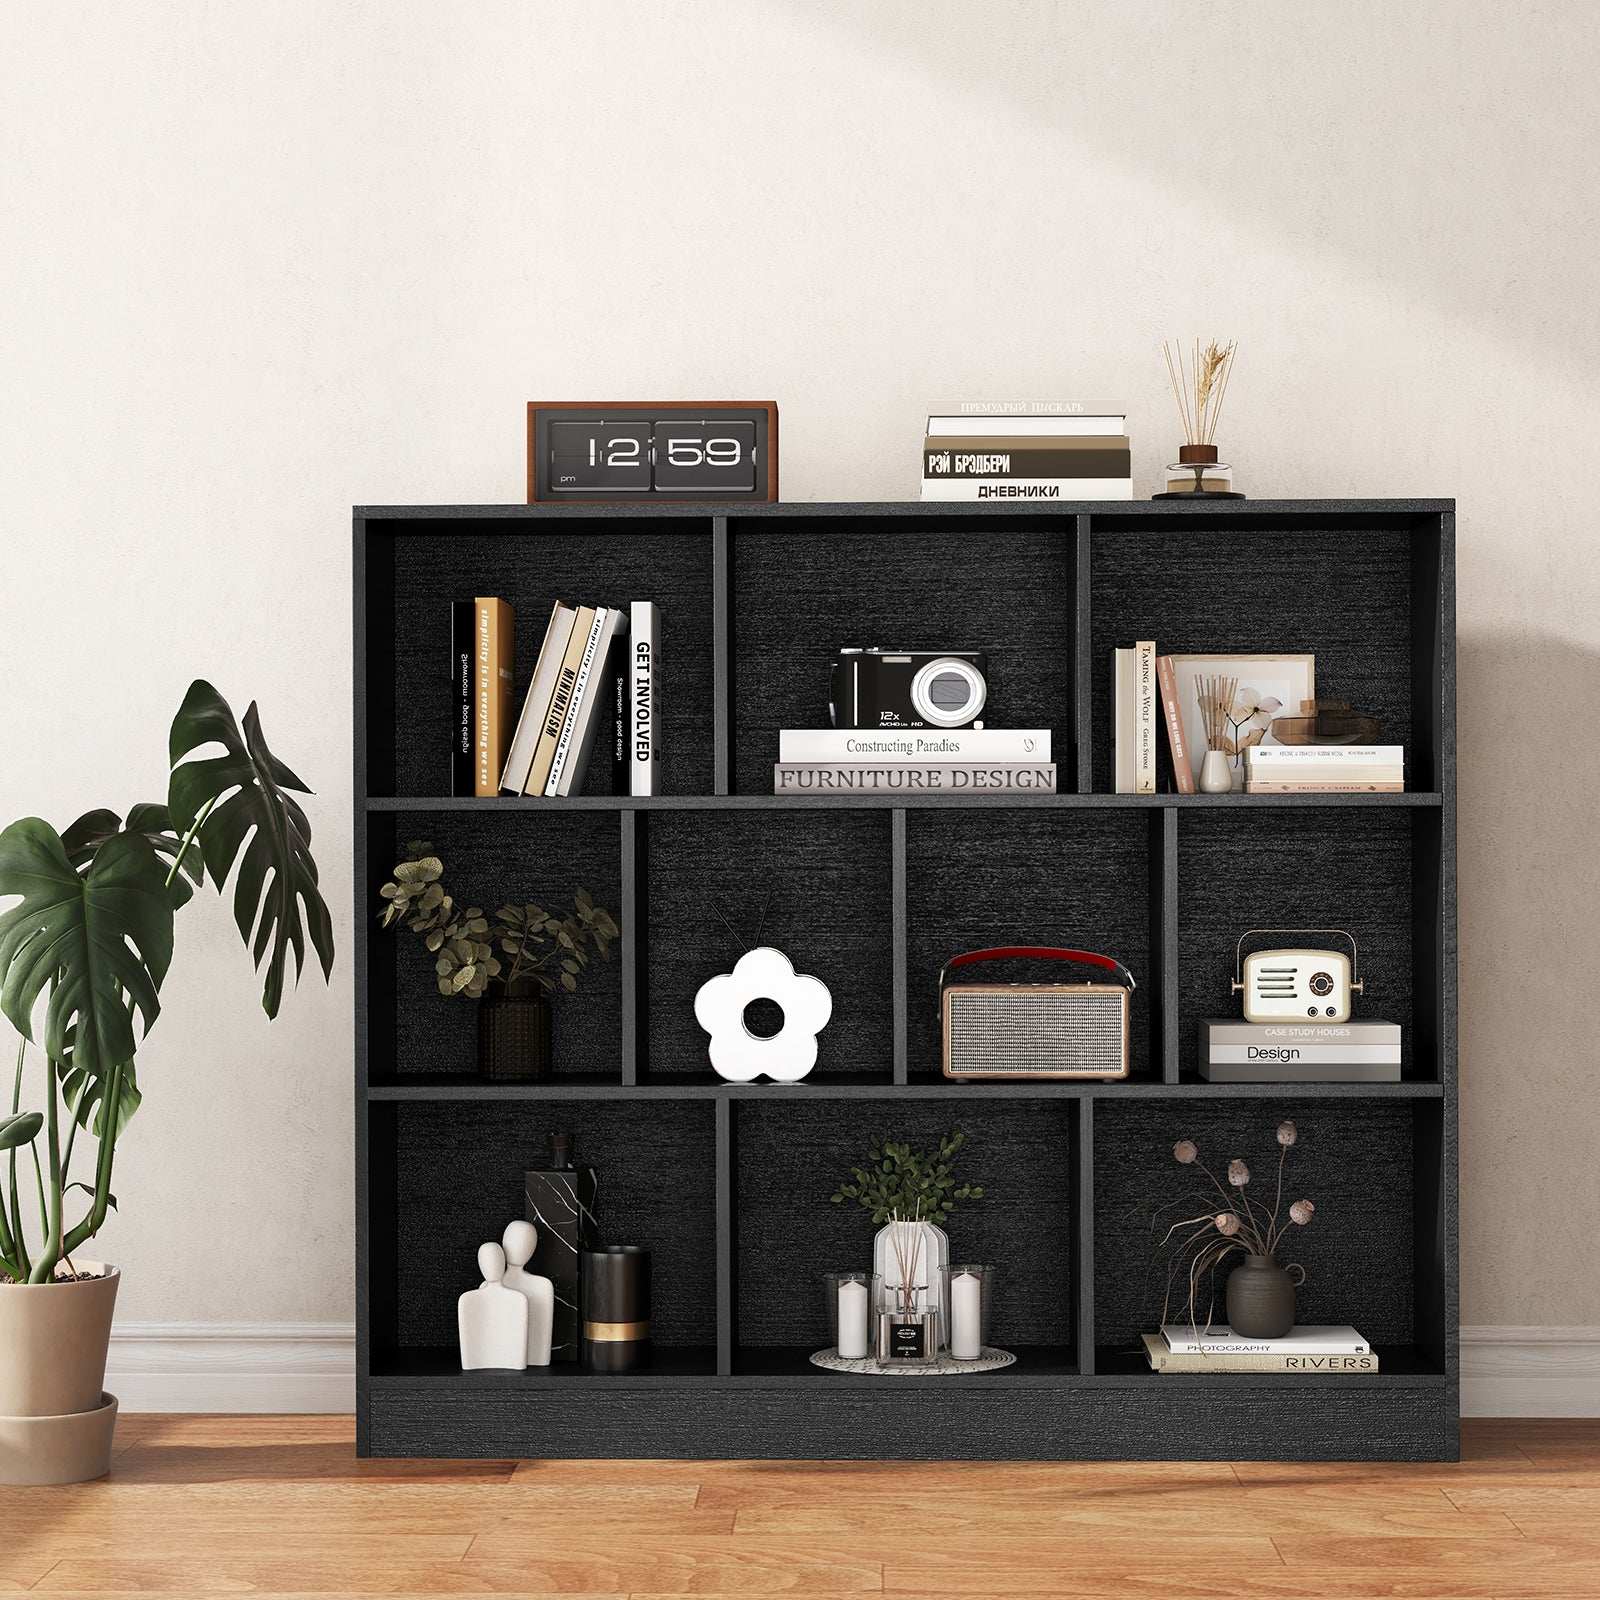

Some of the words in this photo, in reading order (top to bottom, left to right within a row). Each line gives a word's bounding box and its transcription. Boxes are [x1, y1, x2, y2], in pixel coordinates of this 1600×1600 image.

[961, 401, 1026, 413] ПРЕМУДРЫЙ
[1032, 403, 1083, 413] ПИСКАРЬ
[668, 438, 741, 466] 59
[928, 451, 950, 473] РЭЙ
[955, 454, 1010, 474] БРЭДБЕРИ
[978, 486, 1059, 498] ДНЕВНИКИ
[480, 609, 489, 662] simplicity
[583, 619, 601, 668] simplicity
[636, 642, 650, 673] GET
[1142, 646, 1151, 683] TAMING
[481, 665, 489, 674] is
[481, 678, 489, 688] in
[545, 667, 575, 738] MINIMALISM
[1142, 696, 1151, 723] WOLF
[480, 691, 489, 748] everything
[560, 696, 579, 749] everything
[636, 678, 650, 762] INVOLVED
[880, 711, 900, 720] 12x
[846, 739, 913, 755] Constructing
[916, 739, 960, 753] Paradies
[481, 751, 488, 765] we
[556, 752, 563, 765] we
[551, 769, 559, 785] see
[779, 770, 942, 788] FURNITURE
[951, 770, 1054, 788] DESIGN
[1264, 1028, 1287, 1036] CASE
[1288, 1028, 1315, 1036] STUDY
[1317, 1028, 1351, 1036] HOUSES
[1248, 1046, 1300, 1063] Design
[1286, 1358, 1372, 1369] RIVERS
